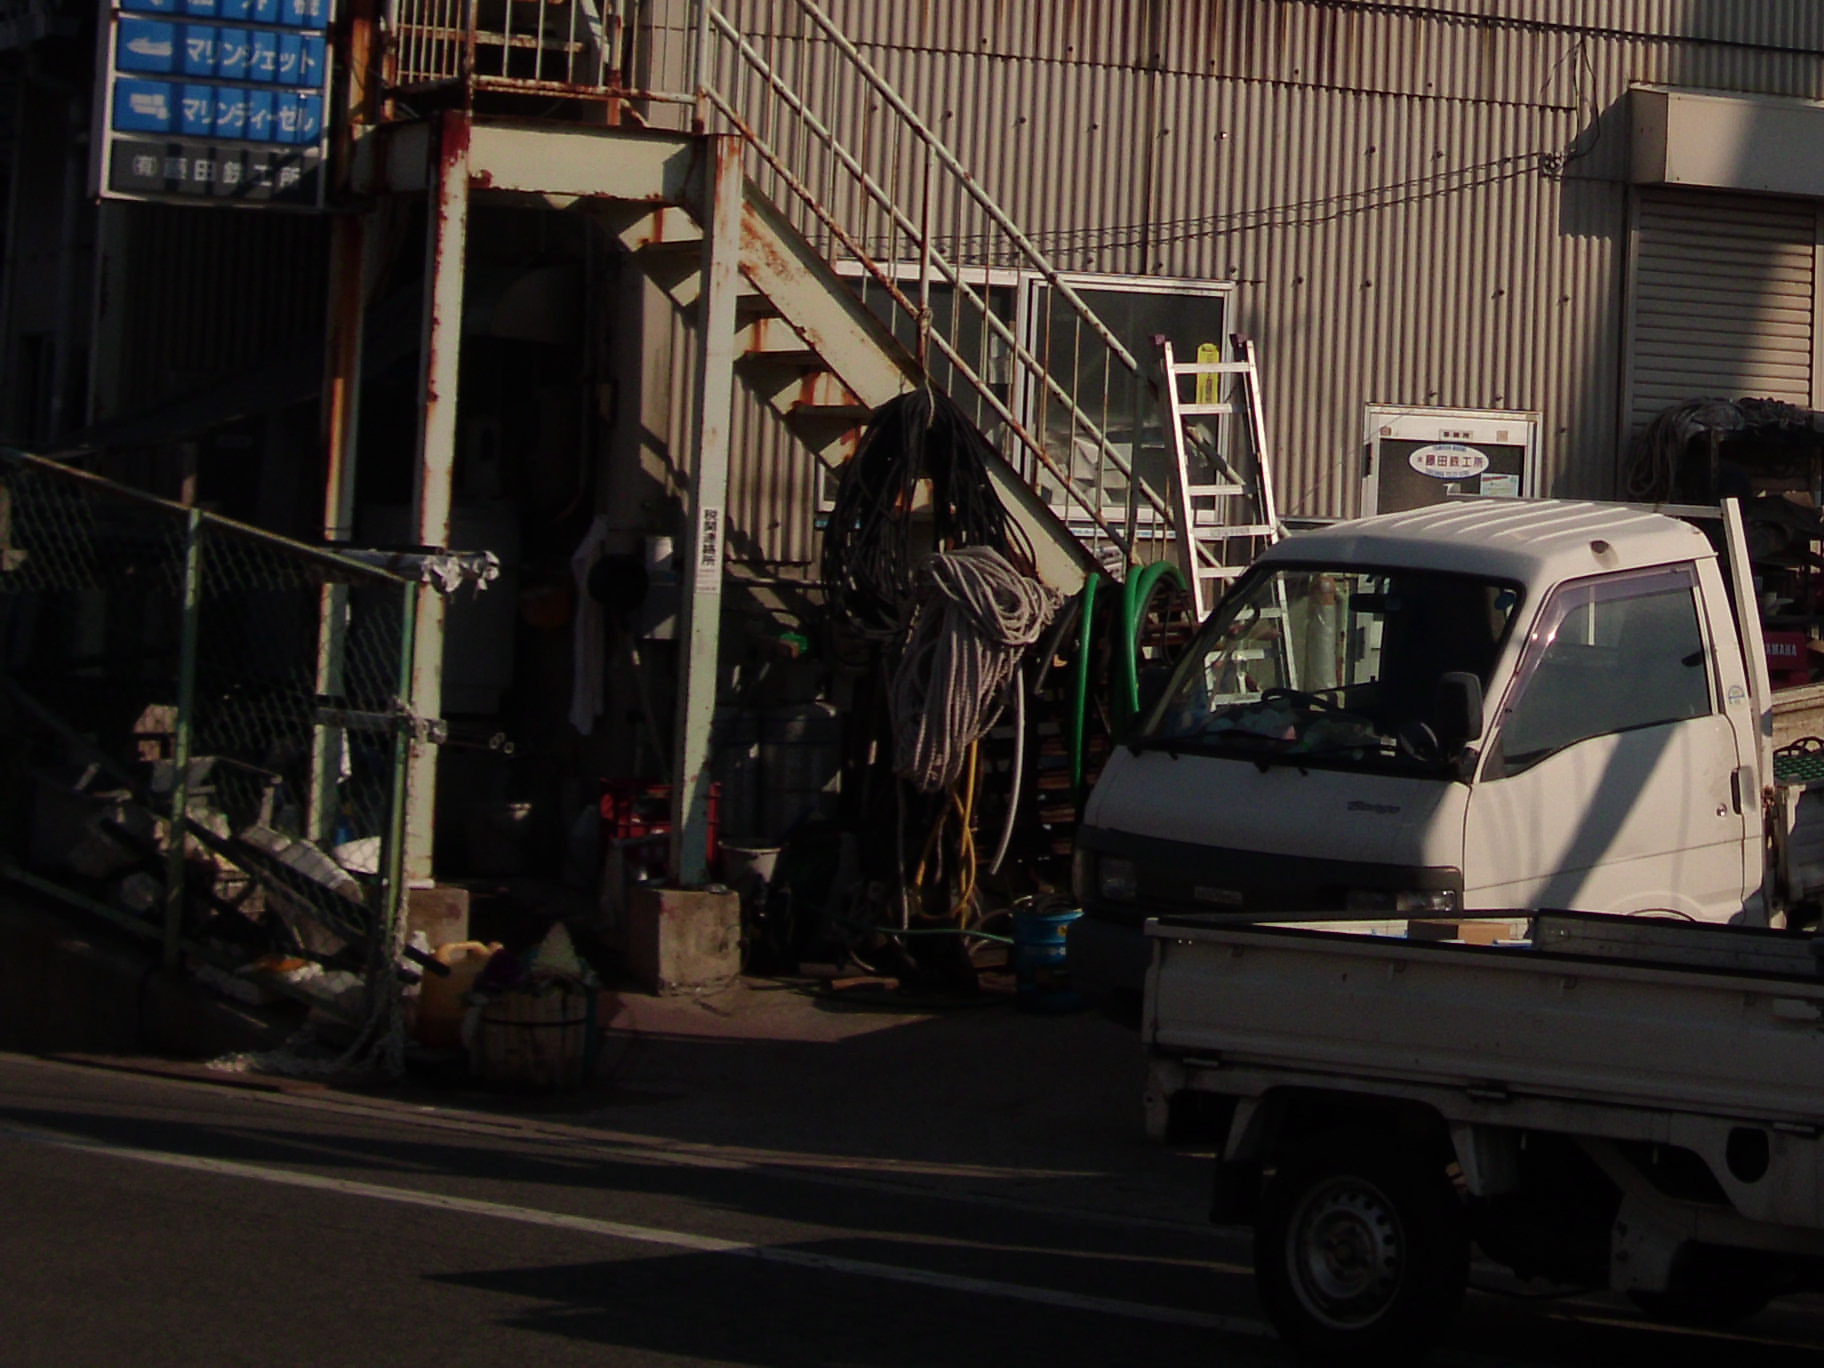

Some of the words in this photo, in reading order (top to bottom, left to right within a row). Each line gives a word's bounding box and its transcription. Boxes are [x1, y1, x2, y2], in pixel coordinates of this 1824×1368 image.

[185, 37, 316, 75] マリンジェット
[182, 97, 315, 132] マリンディーゼル
[1766, 642, 1797, 657] AMAHA
